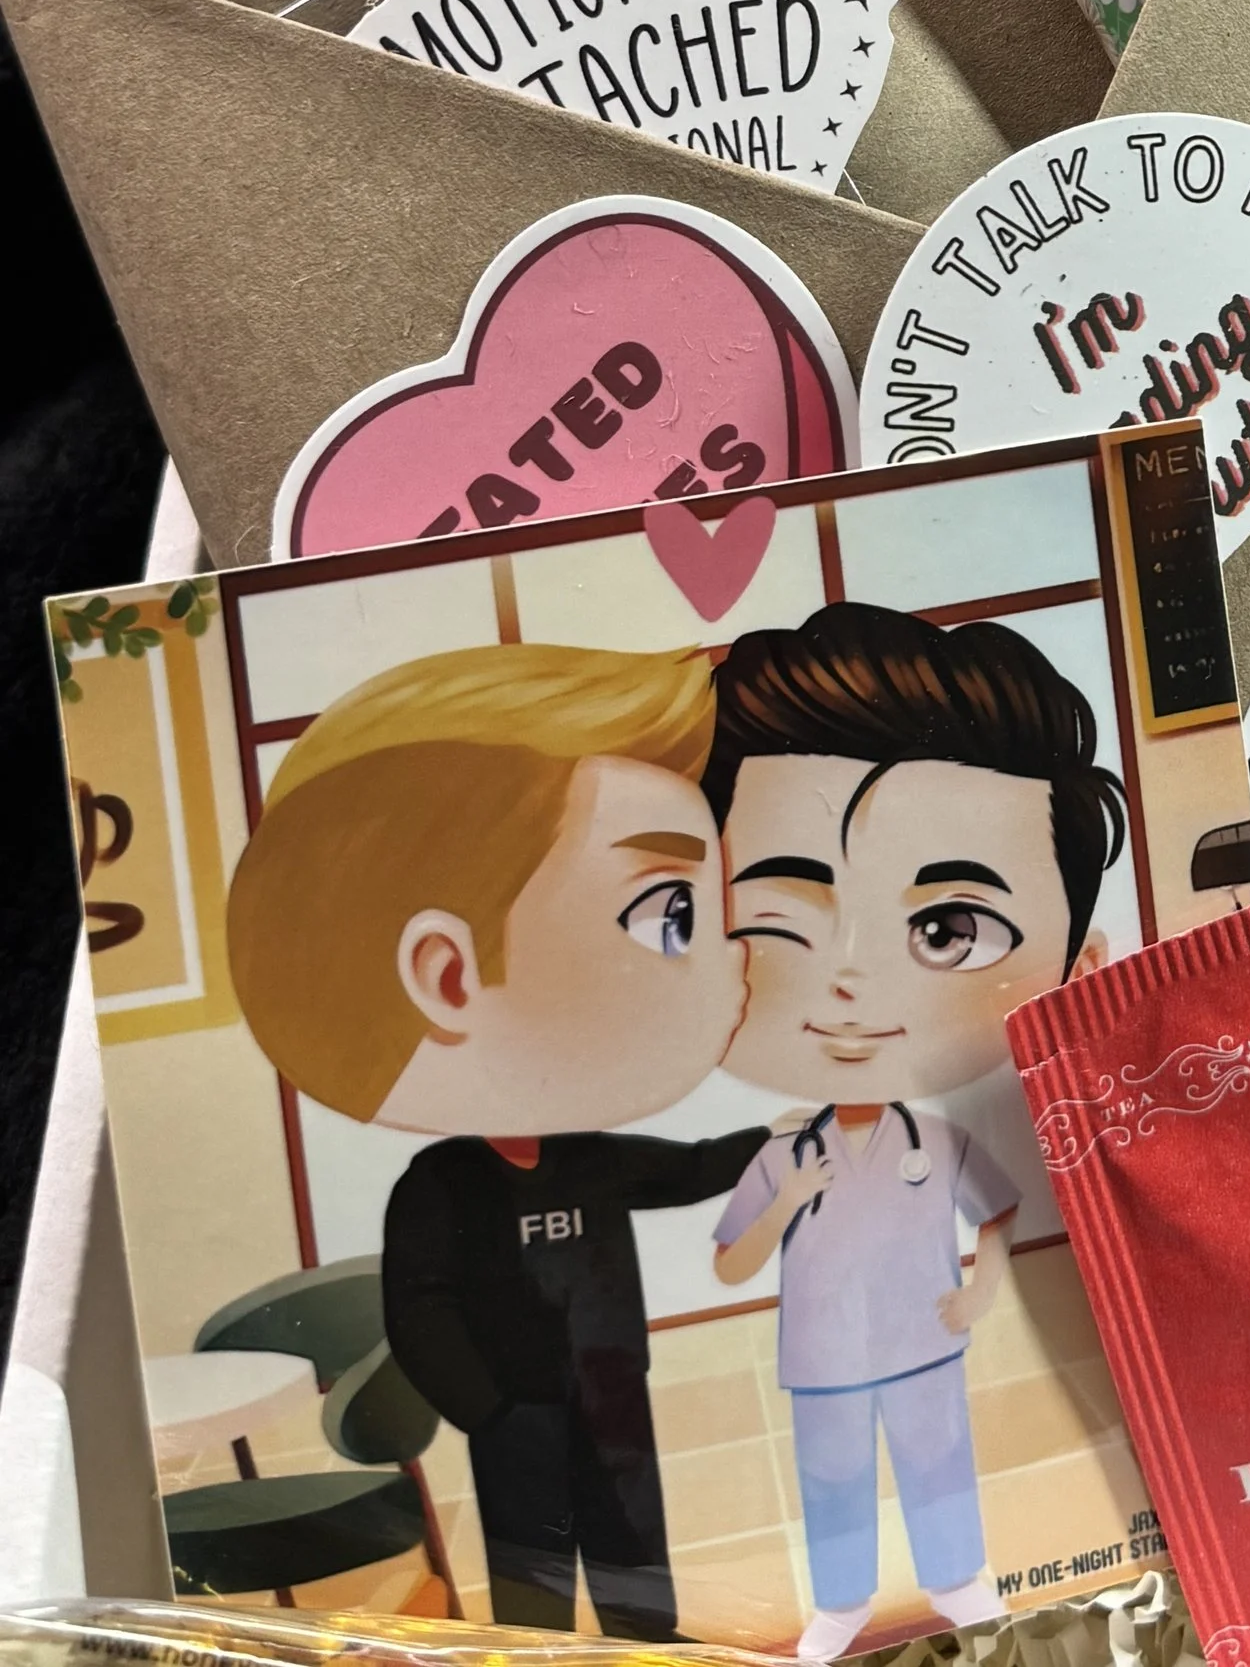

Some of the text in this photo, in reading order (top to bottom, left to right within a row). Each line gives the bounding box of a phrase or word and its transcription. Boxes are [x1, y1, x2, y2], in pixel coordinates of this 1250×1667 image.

[932, 146, 1111, 297] TALK
[1128, 133, 1224, 203] TO
[1100, 1091, 1156, 1124] TEA
[520, 1207, 584, 1245] FBI
[996, 1571, 1024, 1597] MY
[1028, 1542, 1123, 1589] ONE-NIGHT
